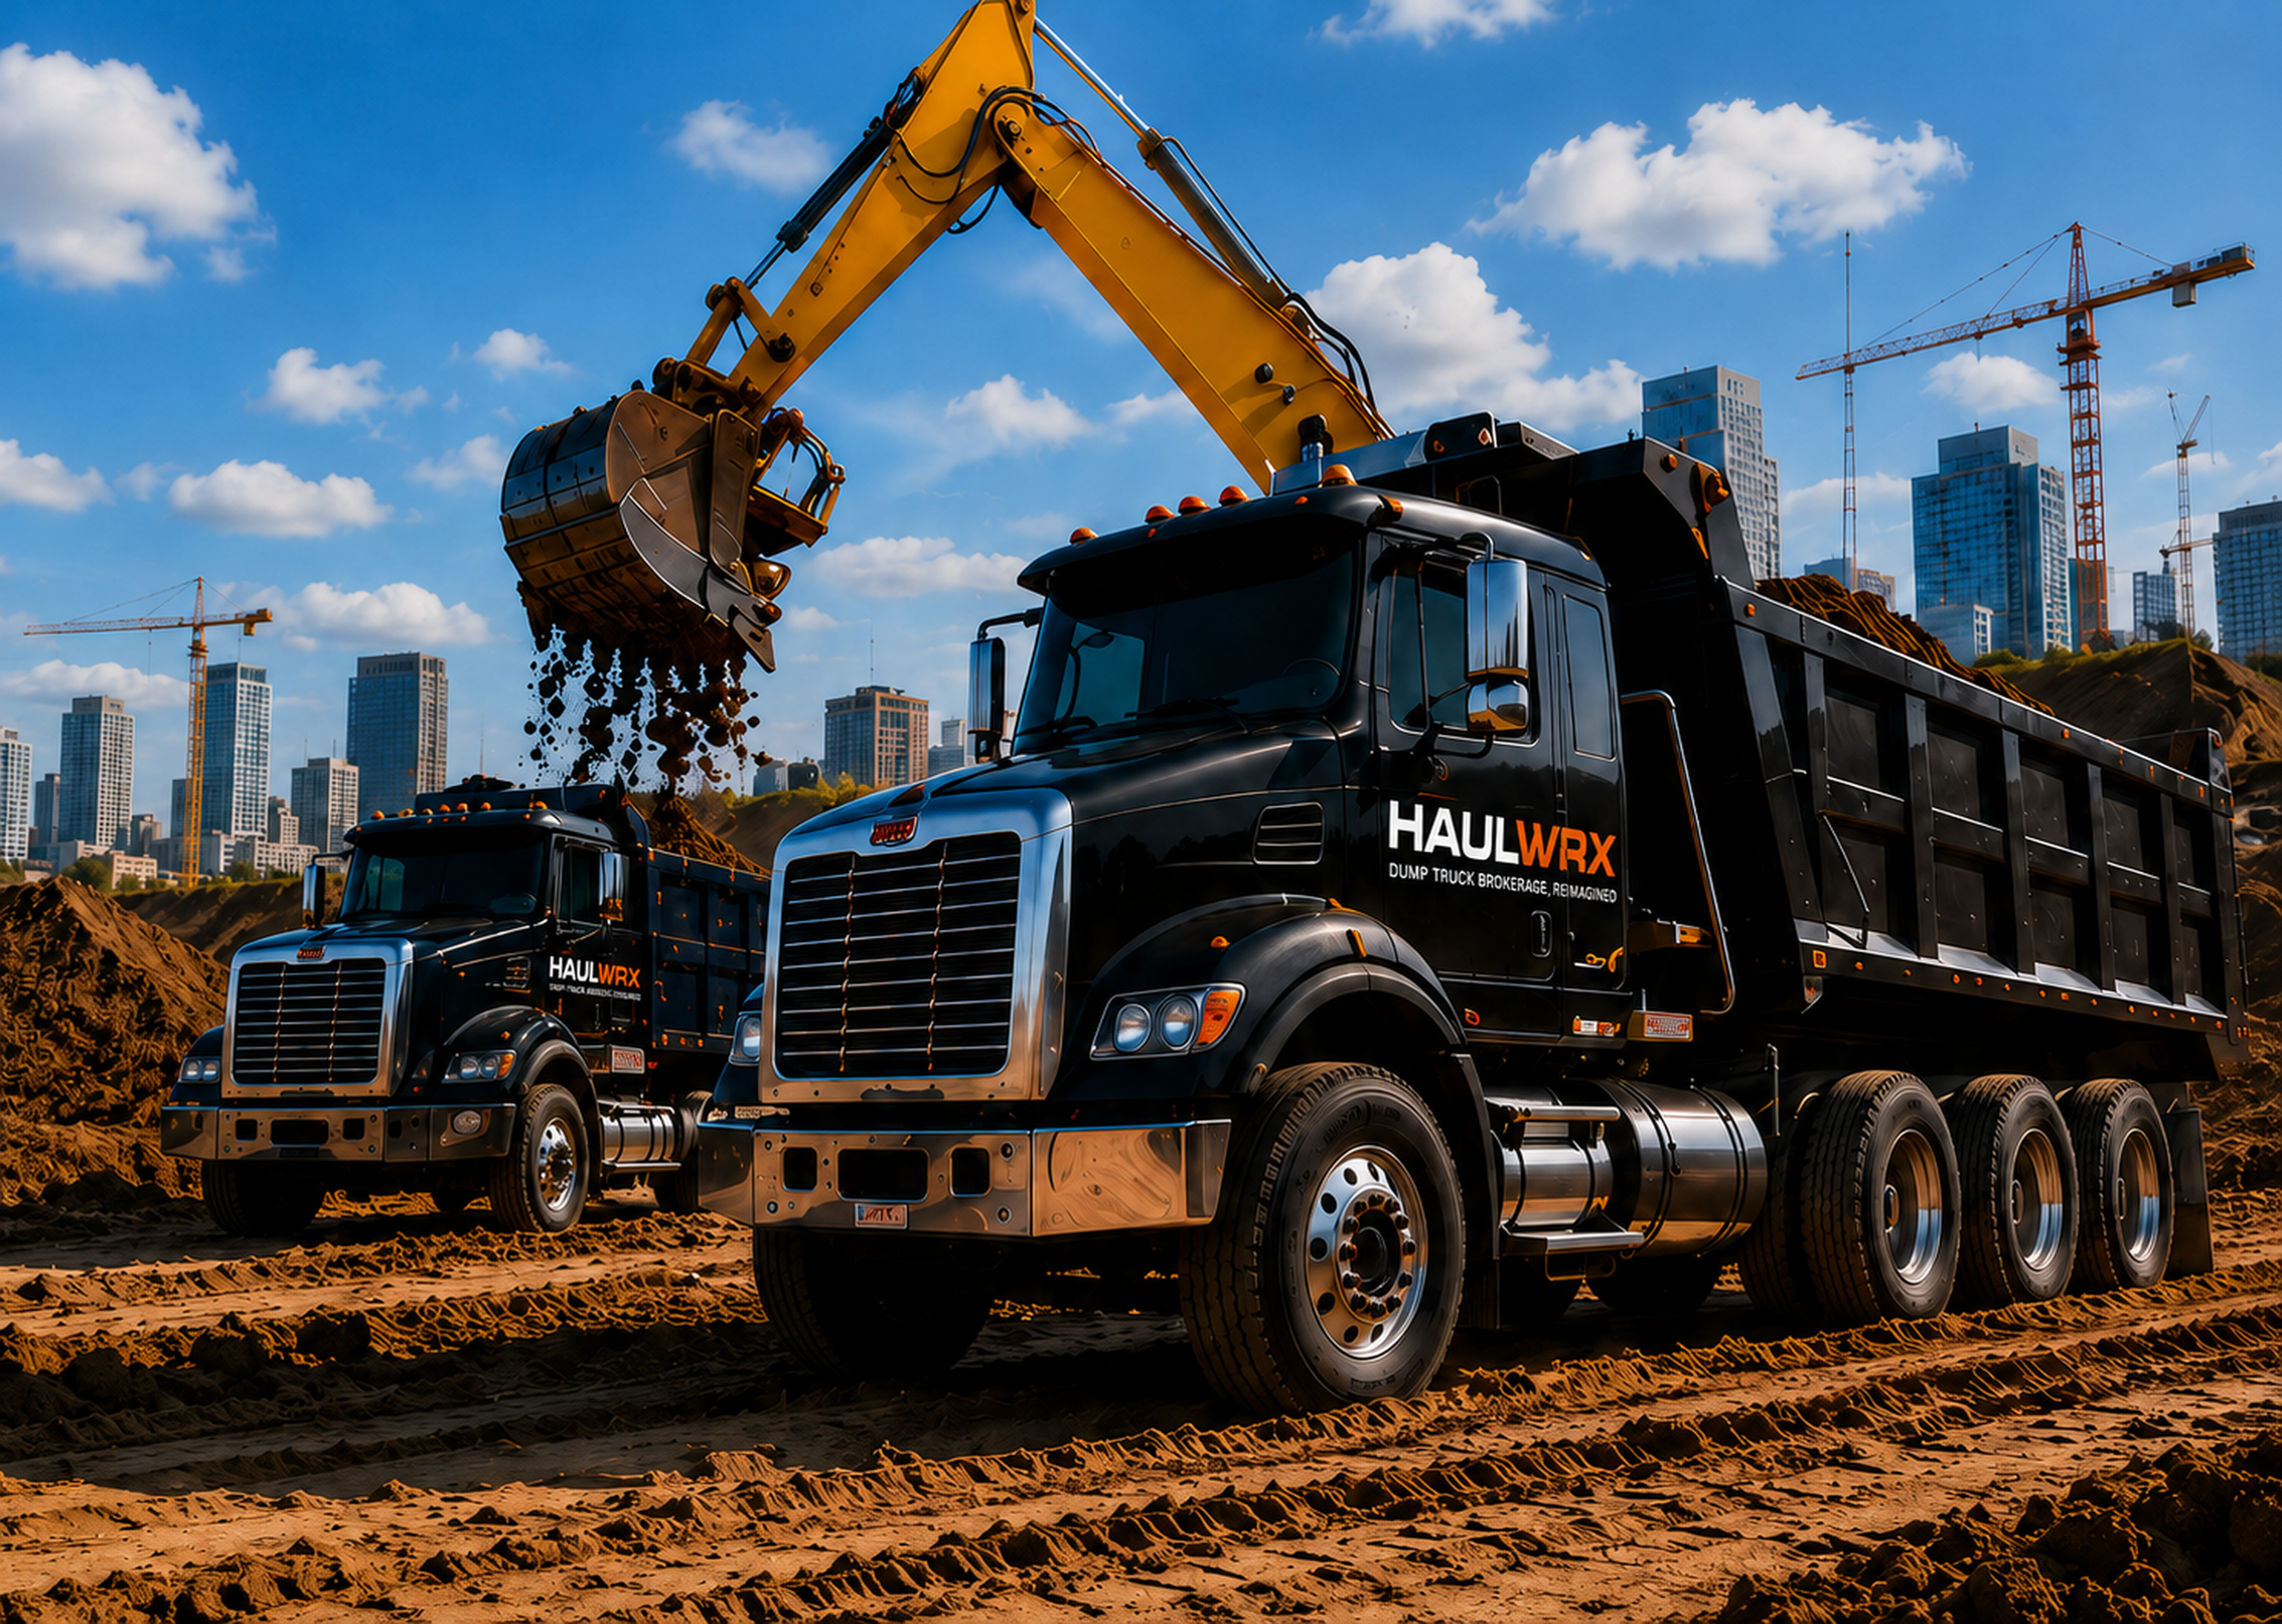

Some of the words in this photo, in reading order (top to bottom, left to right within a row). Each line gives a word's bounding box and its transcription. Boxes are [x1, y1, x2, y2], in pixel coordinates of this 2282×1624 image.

[1388, 800, 1617, 877] HAULWRX
[1388, 863, 1429, 879] DUMP
[1432, 867, 1475, 886] TRUCK
[1478, 875, 1551, 897] BROKERAGE,
[549, 955, 641, 989] HAULWRX
